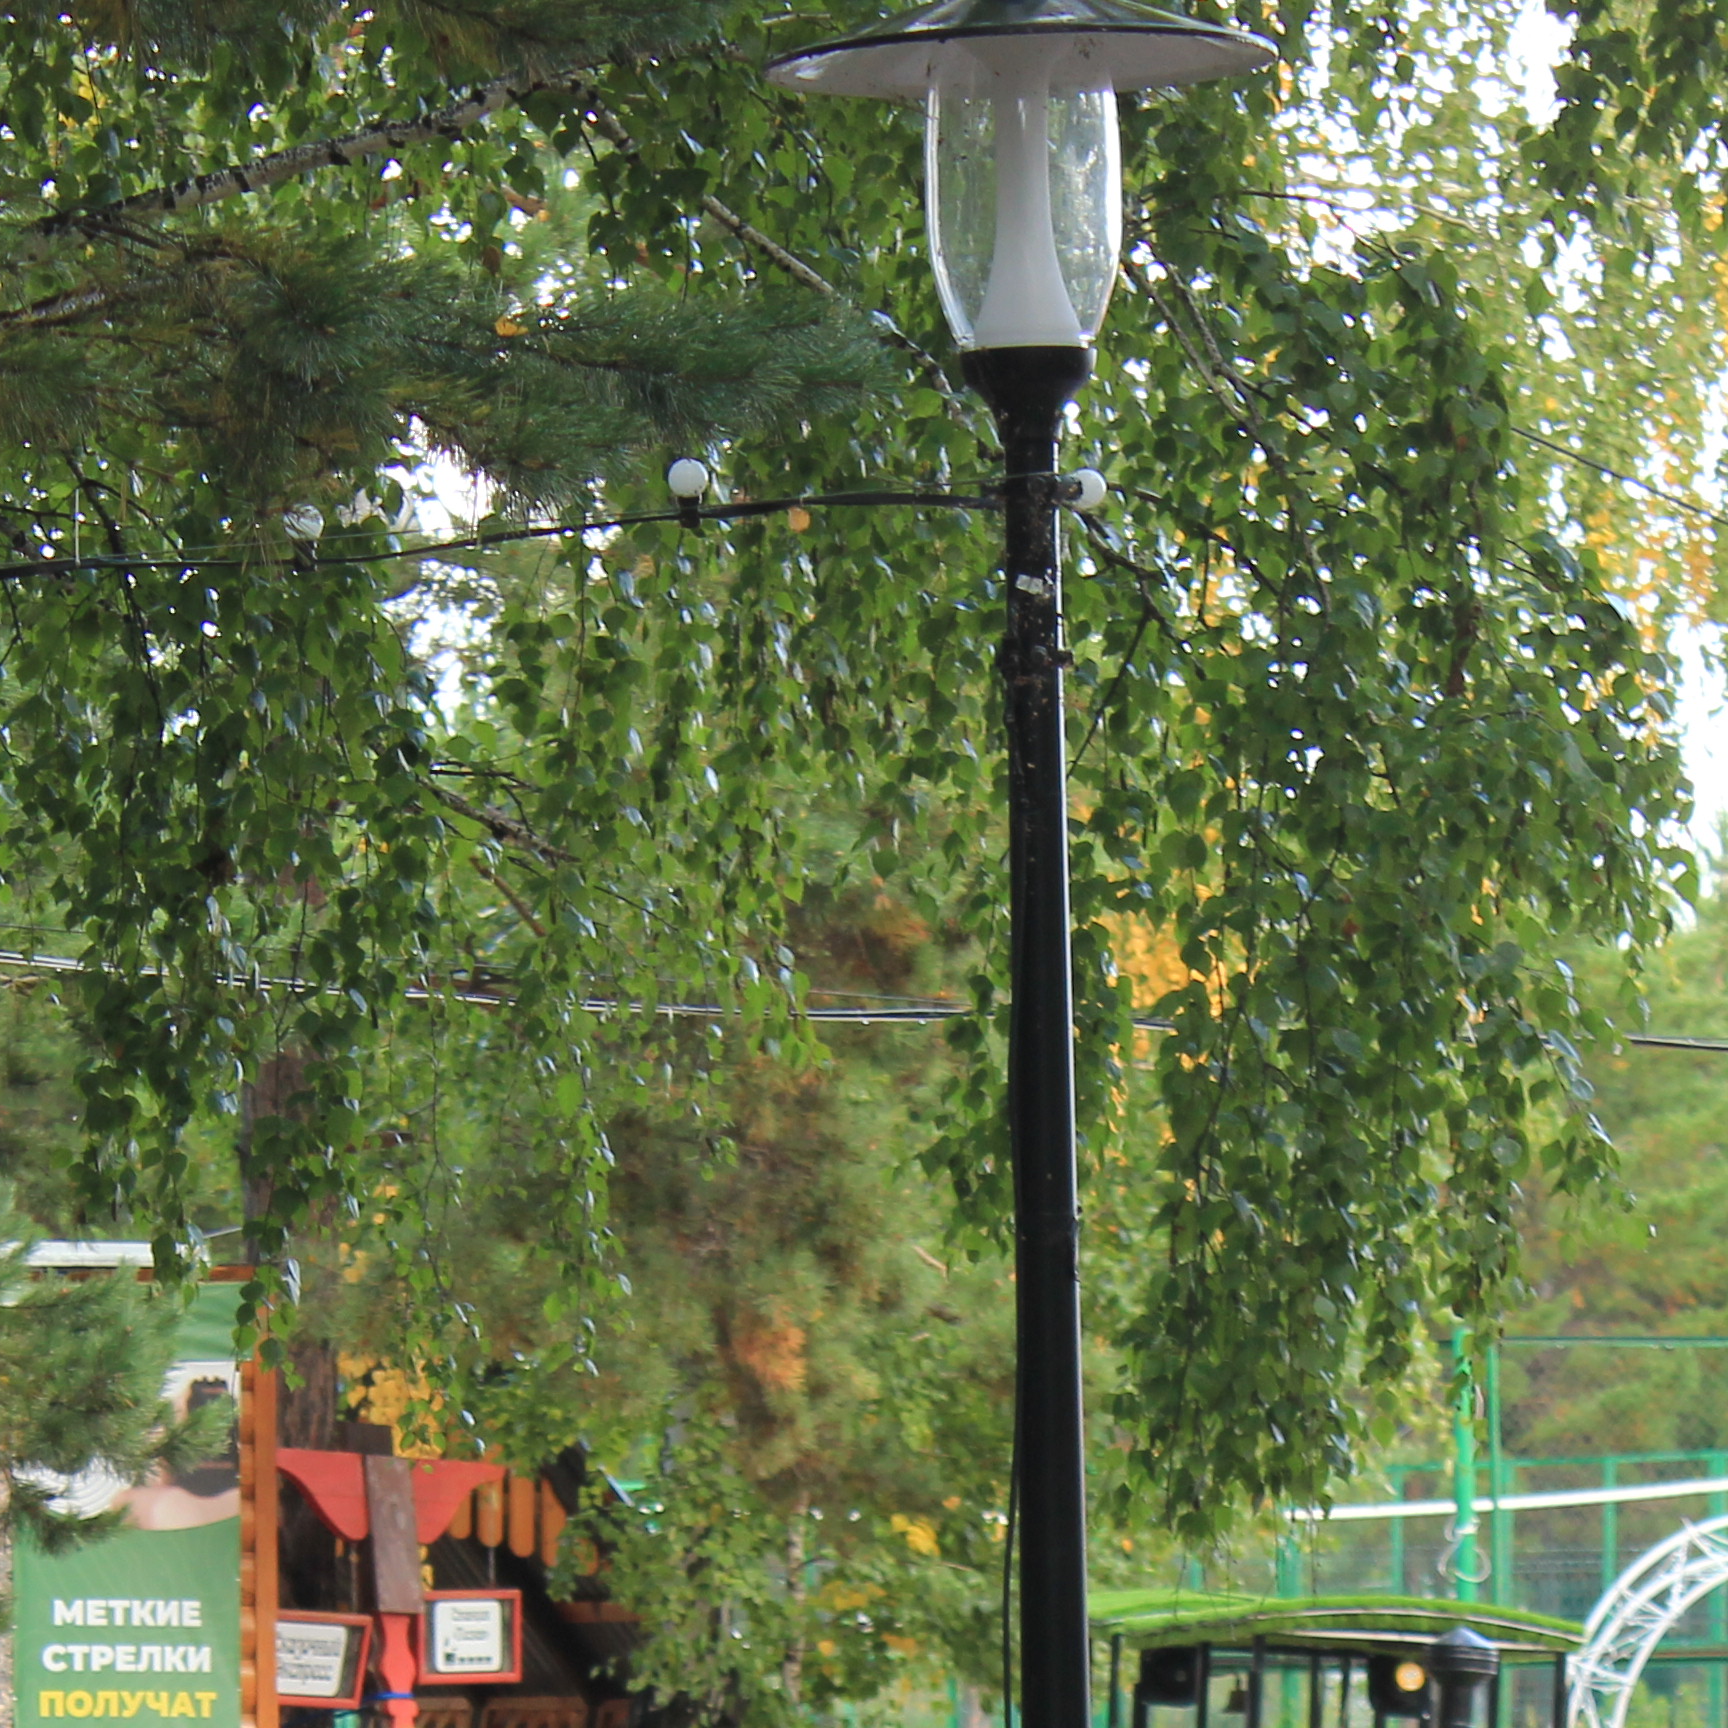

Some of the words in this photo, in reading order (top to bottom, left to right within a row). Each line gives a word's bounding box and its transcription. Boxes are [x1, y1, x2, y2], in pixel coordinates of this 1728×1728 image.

[52, 1598, 203, 1628] МЕТКИЕ
[41, 1644, 212, 1673] СТРЕЛКИ
[38, 1690, 217, 1718] ПОЛУЧАТ
